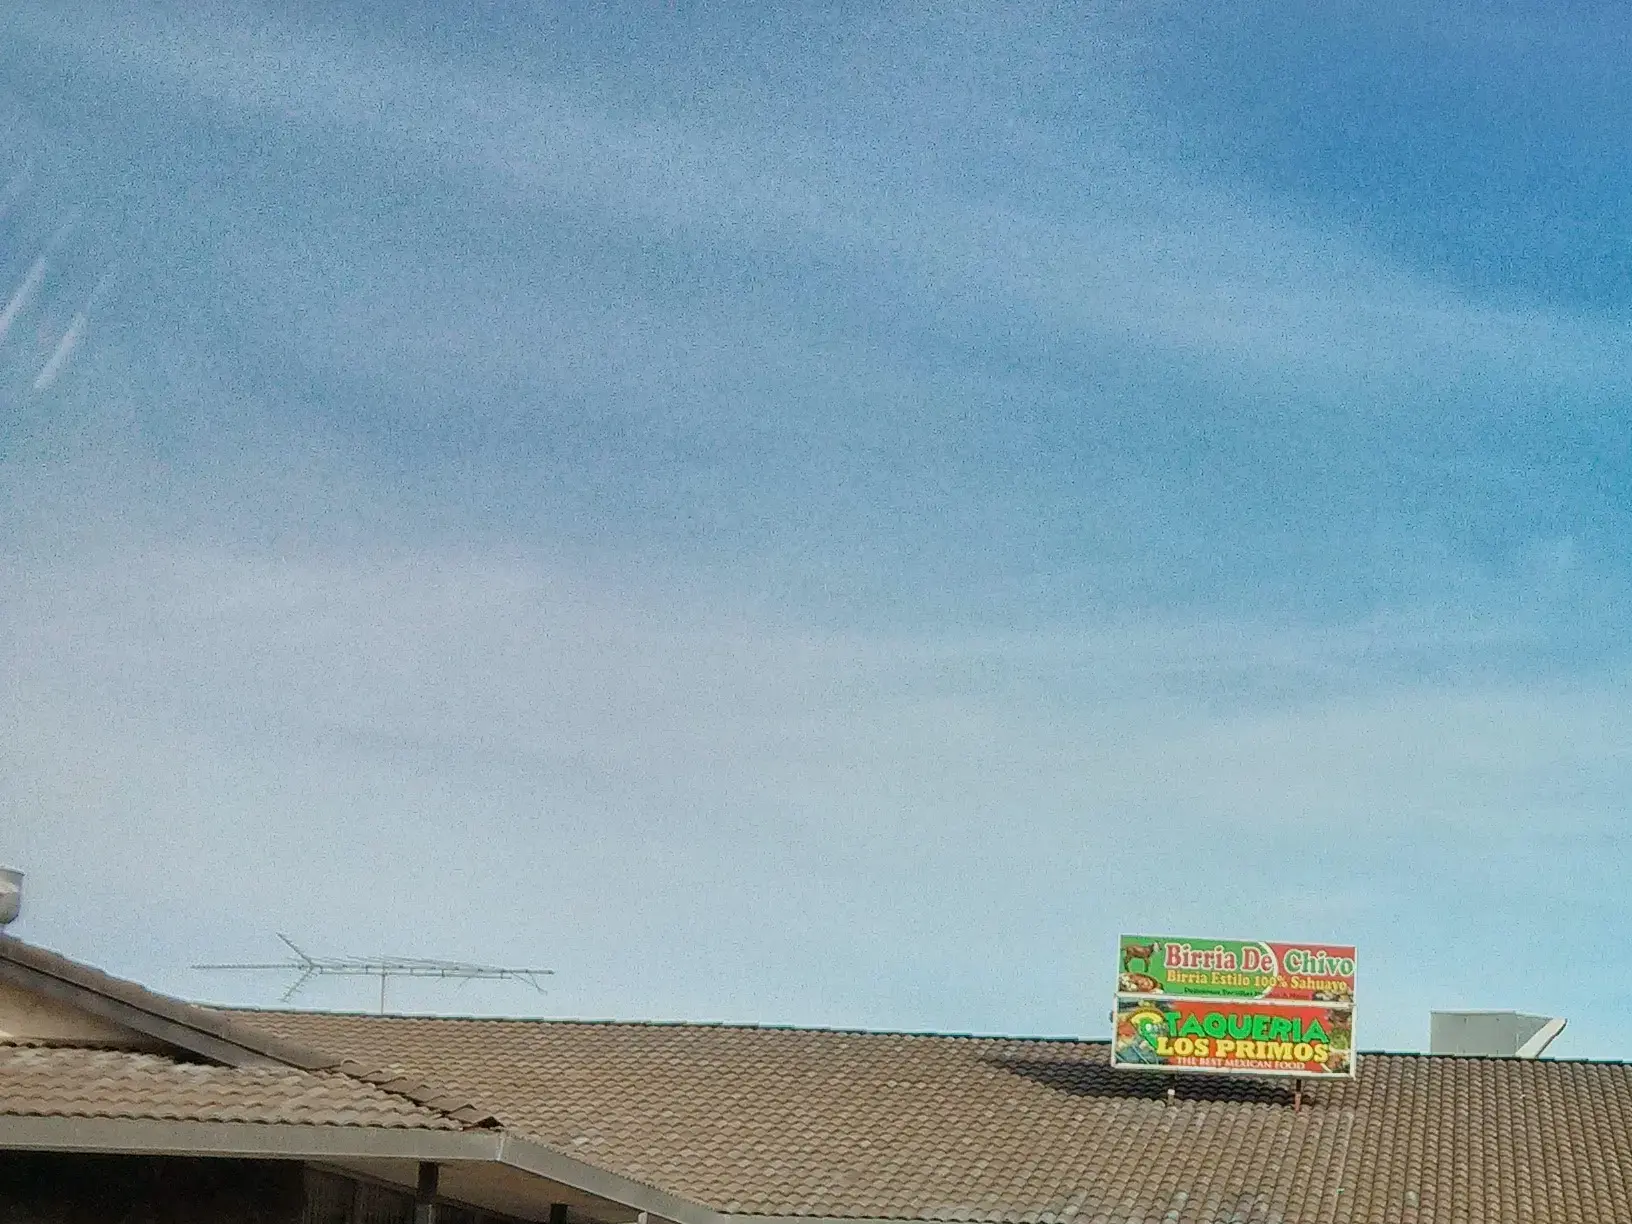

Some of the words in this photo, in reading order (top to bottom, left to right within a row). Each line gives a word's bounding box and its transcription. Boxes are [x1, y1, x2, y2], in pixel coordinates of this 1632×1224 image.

[1165, 943, 1235, 970] Birria
[1241, 947, 1272, 972] De
[1284, 950, 1354, 976] Chivo
[1167, 971, 1207, 985] Birria
[1211, 973, 1250, 987] Estilo
[1253, 976, 1287, 988] 100%
[1291, 977, 1347, 991] Sahuayo
[1166, 1010, 1330, 1043] TAQUERIA
[1156, 1036, 1210, 1057] LOS
[1215, 1040, 1330, 1062] PRIMOS
[1177, 1057, 1197, 1066] THE
[1200, 1058, 1222, 1067] BEST
[1225, 1059, 1272, 1069] MEXICAN
[1274, 1061, 1305, 1070] FOOD
